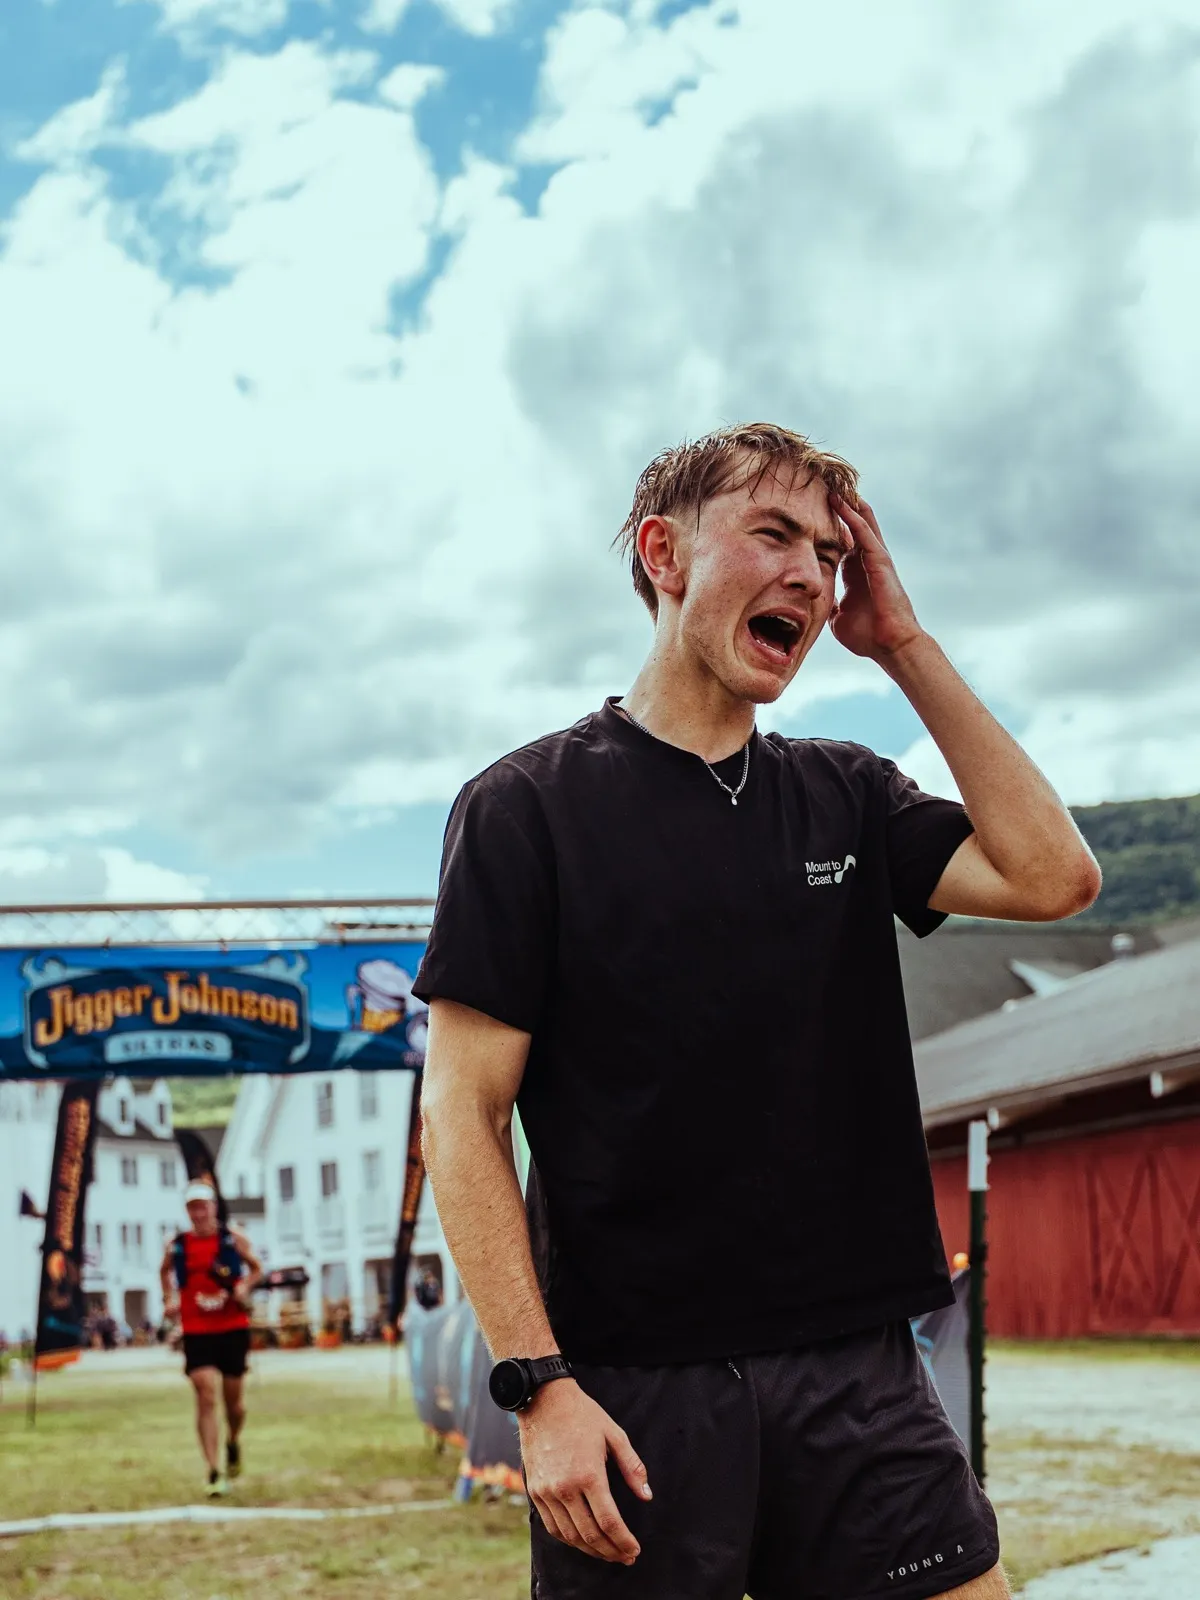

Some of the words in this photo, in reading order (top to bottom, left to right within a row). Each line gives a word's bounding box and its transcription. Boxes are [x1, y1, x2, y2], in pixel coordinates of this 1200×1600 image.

[805, 861, 831, 873] Mount
[832, 860, 841, 871] to
[807, 874, 833, 886] Coast
[35, 985, 152, 1047] Jigger
[152, 971, 298, 1030] Johnson
[887, 1553, 944, 1580] YOUNG
[956, 1544, 964, 1554] A
